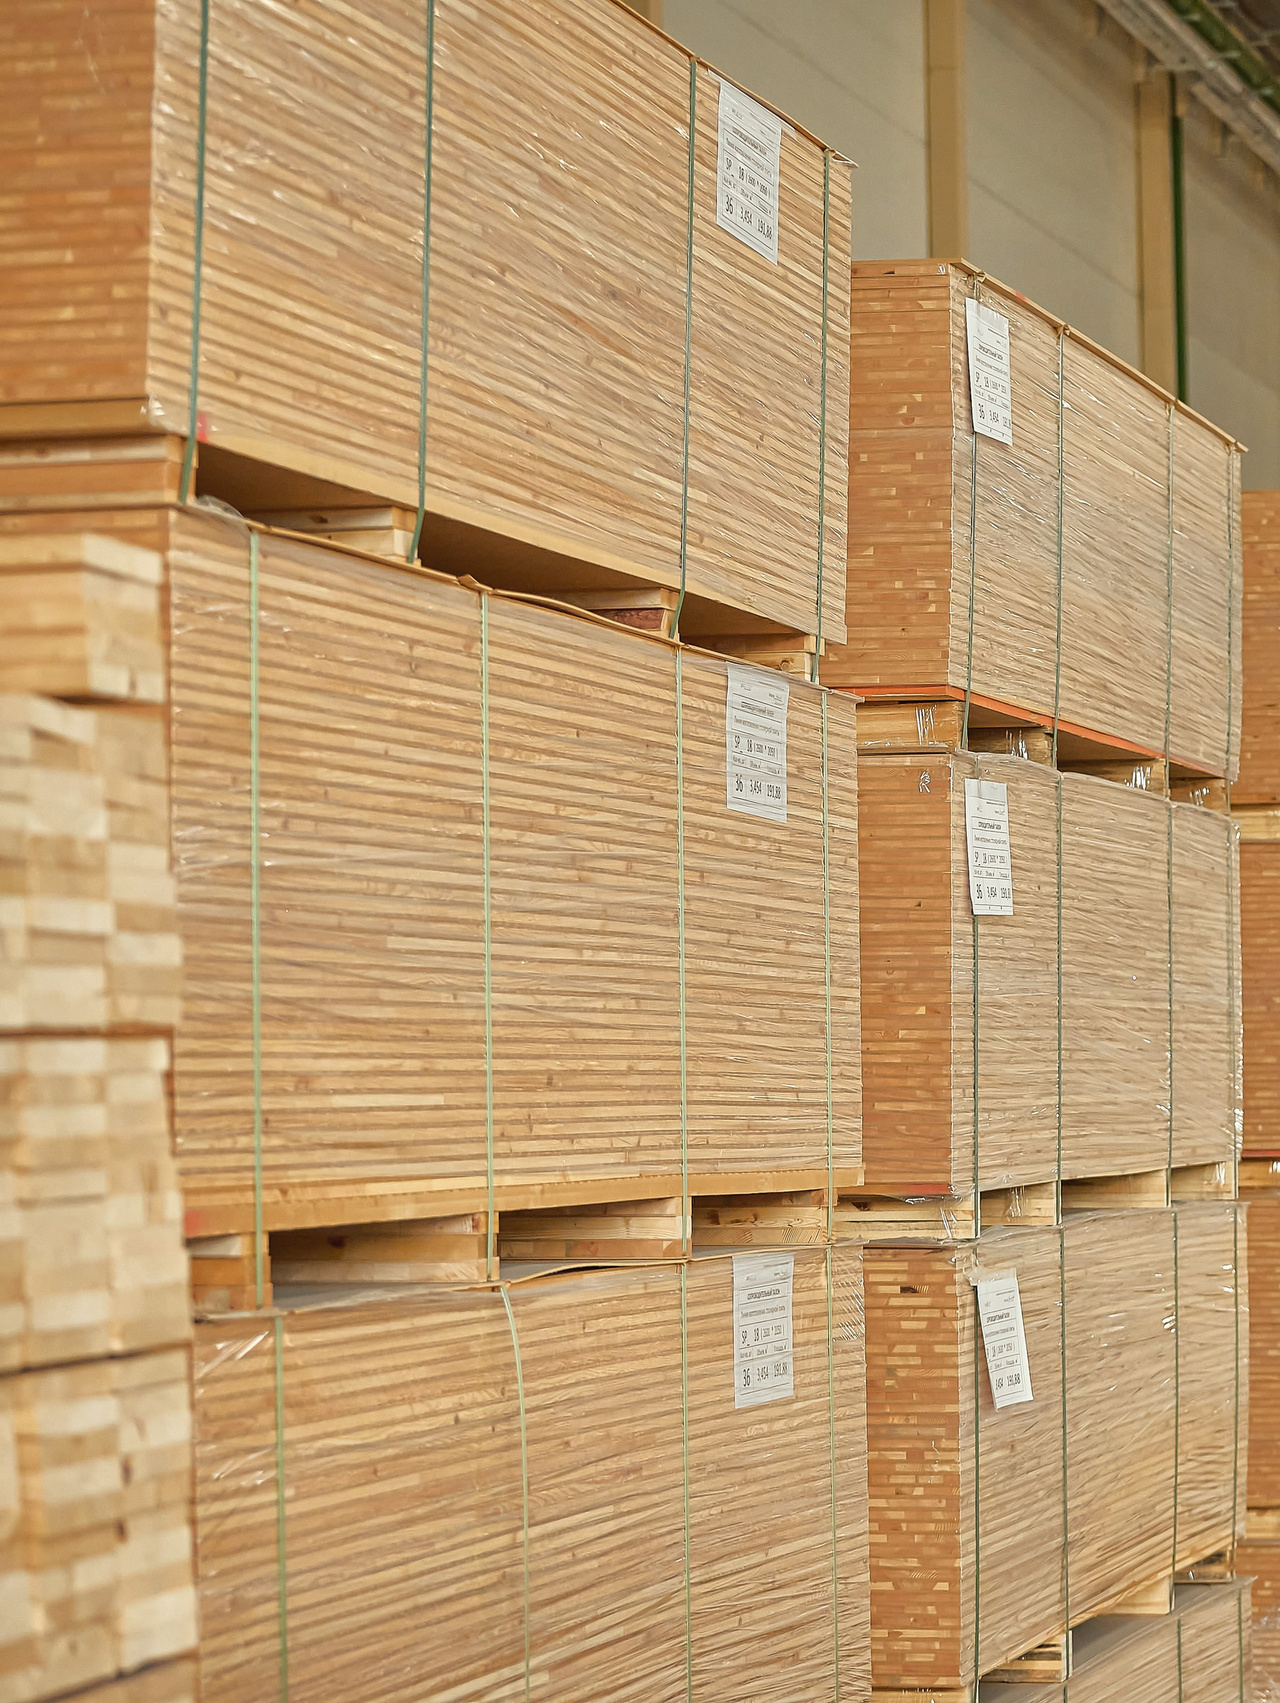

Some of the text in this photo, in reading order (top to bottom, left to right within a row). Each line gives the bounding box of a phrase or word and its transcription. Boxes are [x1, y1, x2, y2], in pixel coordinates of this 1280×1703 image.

[725, 194, 734, 215] 36
[735, 773, 744, 792] 36
[743, 1368, 751, 1387] 36
